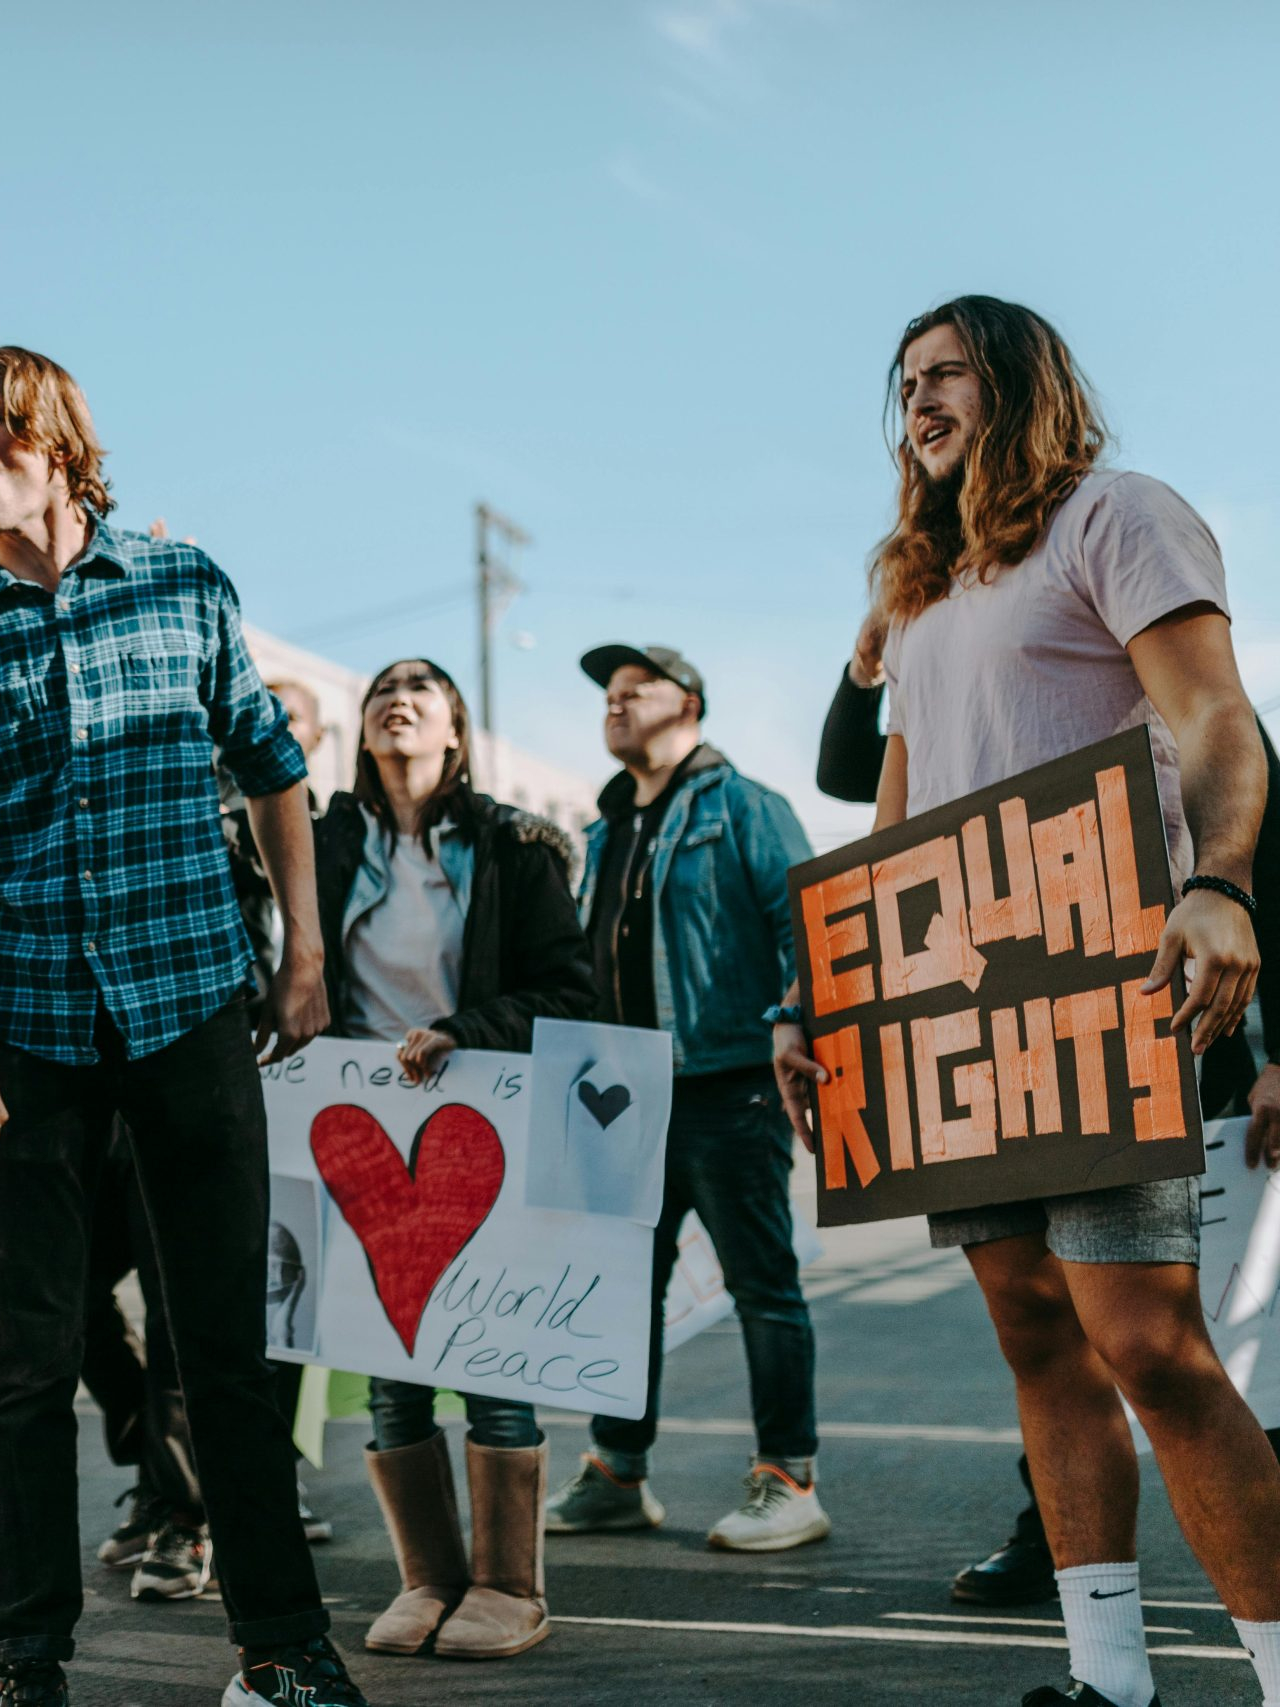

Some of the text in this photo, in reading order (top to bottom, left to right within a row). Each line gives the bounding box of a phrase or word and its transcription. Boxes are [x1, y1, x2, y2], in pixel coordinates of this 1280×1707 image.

[801, 765, 1167, 1017] EQUAL
[492, 1067, 522, 1099] is
[814, 976, 1187, 1190] RIGHTS
[433, 1259, 603, 1339] World
[433, 1317, 628, 1401] Peace
